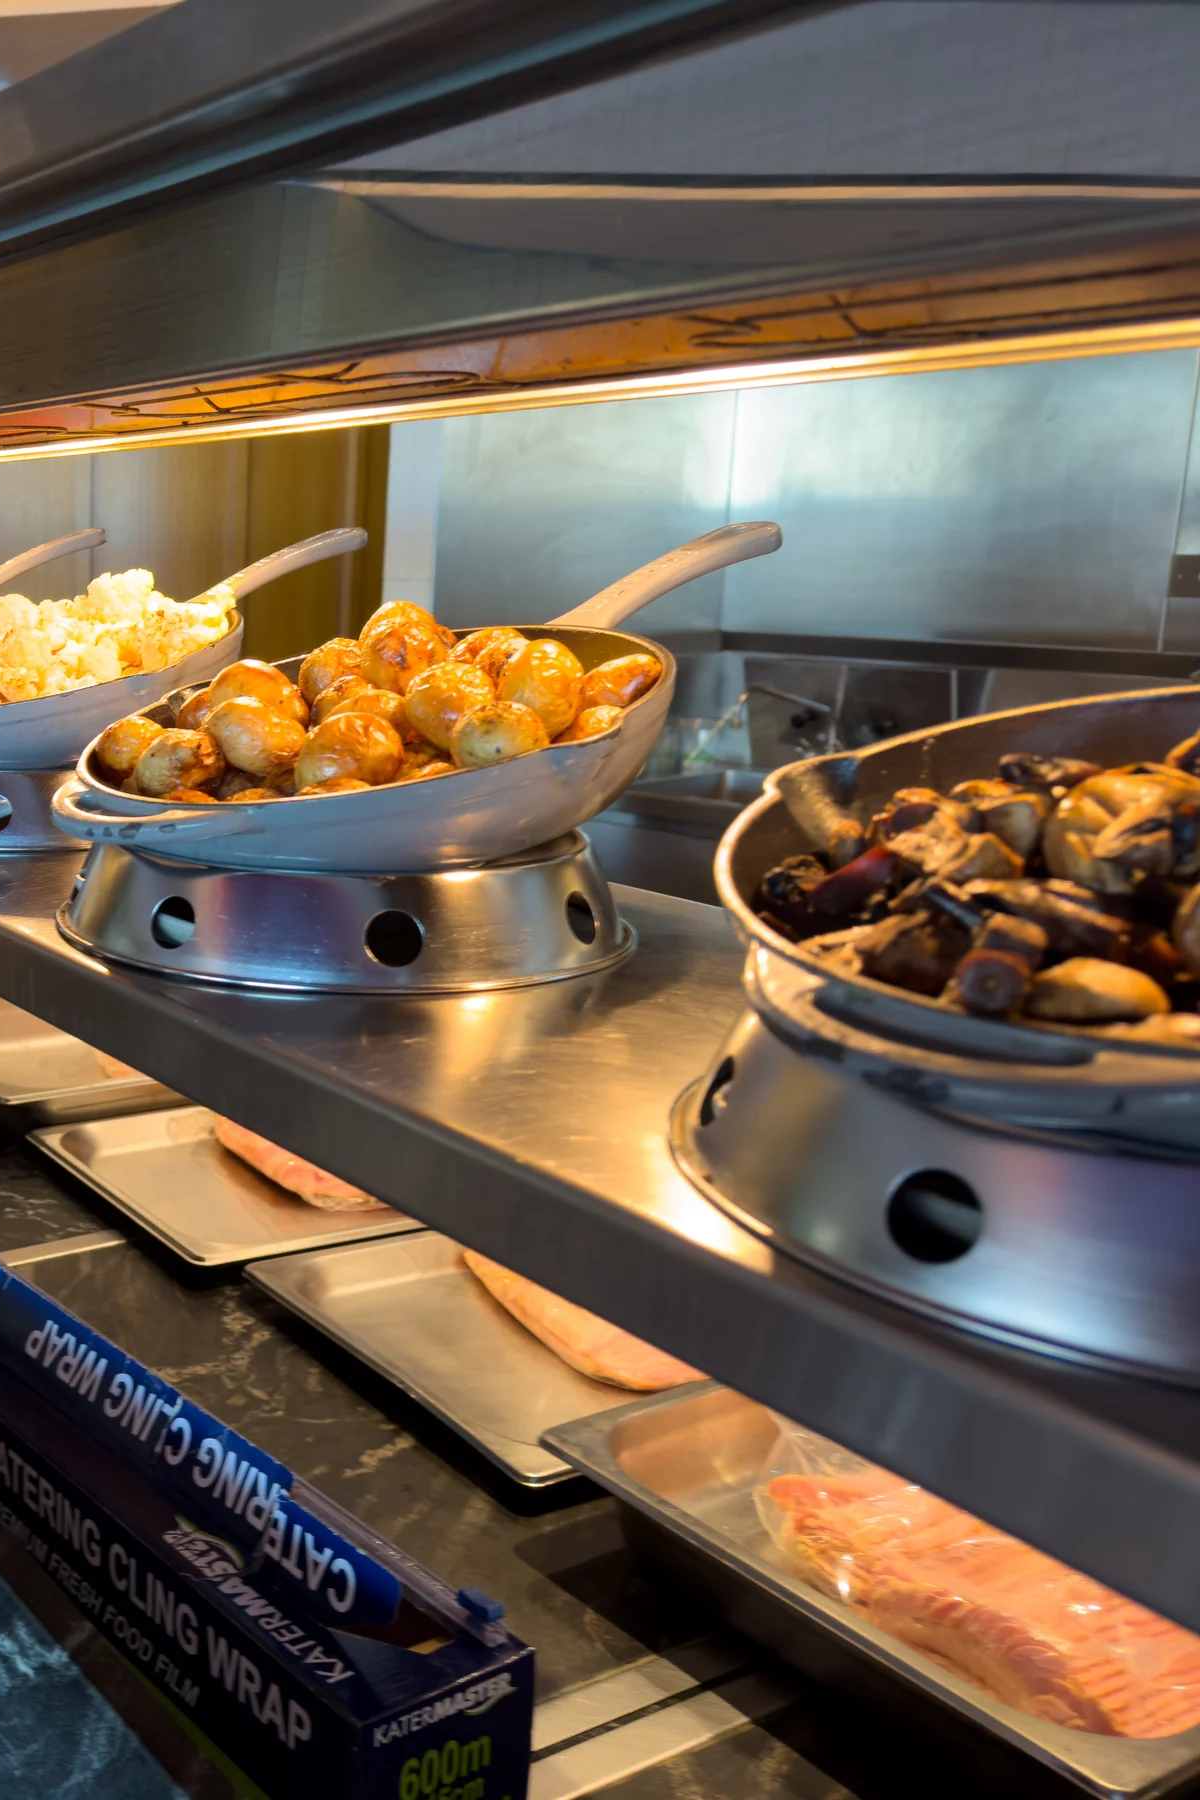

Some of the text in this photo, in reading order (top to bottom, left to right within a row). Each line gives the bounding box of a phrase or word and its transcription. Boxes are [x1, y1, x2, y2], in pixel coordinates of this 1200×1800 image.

[24, 1319, 357, 1613] CATERING CLING WRAP
[48, 1553, 103, 1614] FRESH
[103, 1605, 153, 1661] FOOD
[154, 1655, 200, 1707] FILM
[109, 1543, 198, 1655] CLING
[206, 1625, 312, 1749] WRAP
[161, 1522, 355, 1684] KATERMASTER
[373, 1672, 517, 1747] KATERMASTER
[399, 1735, 492, 1800] 600m
